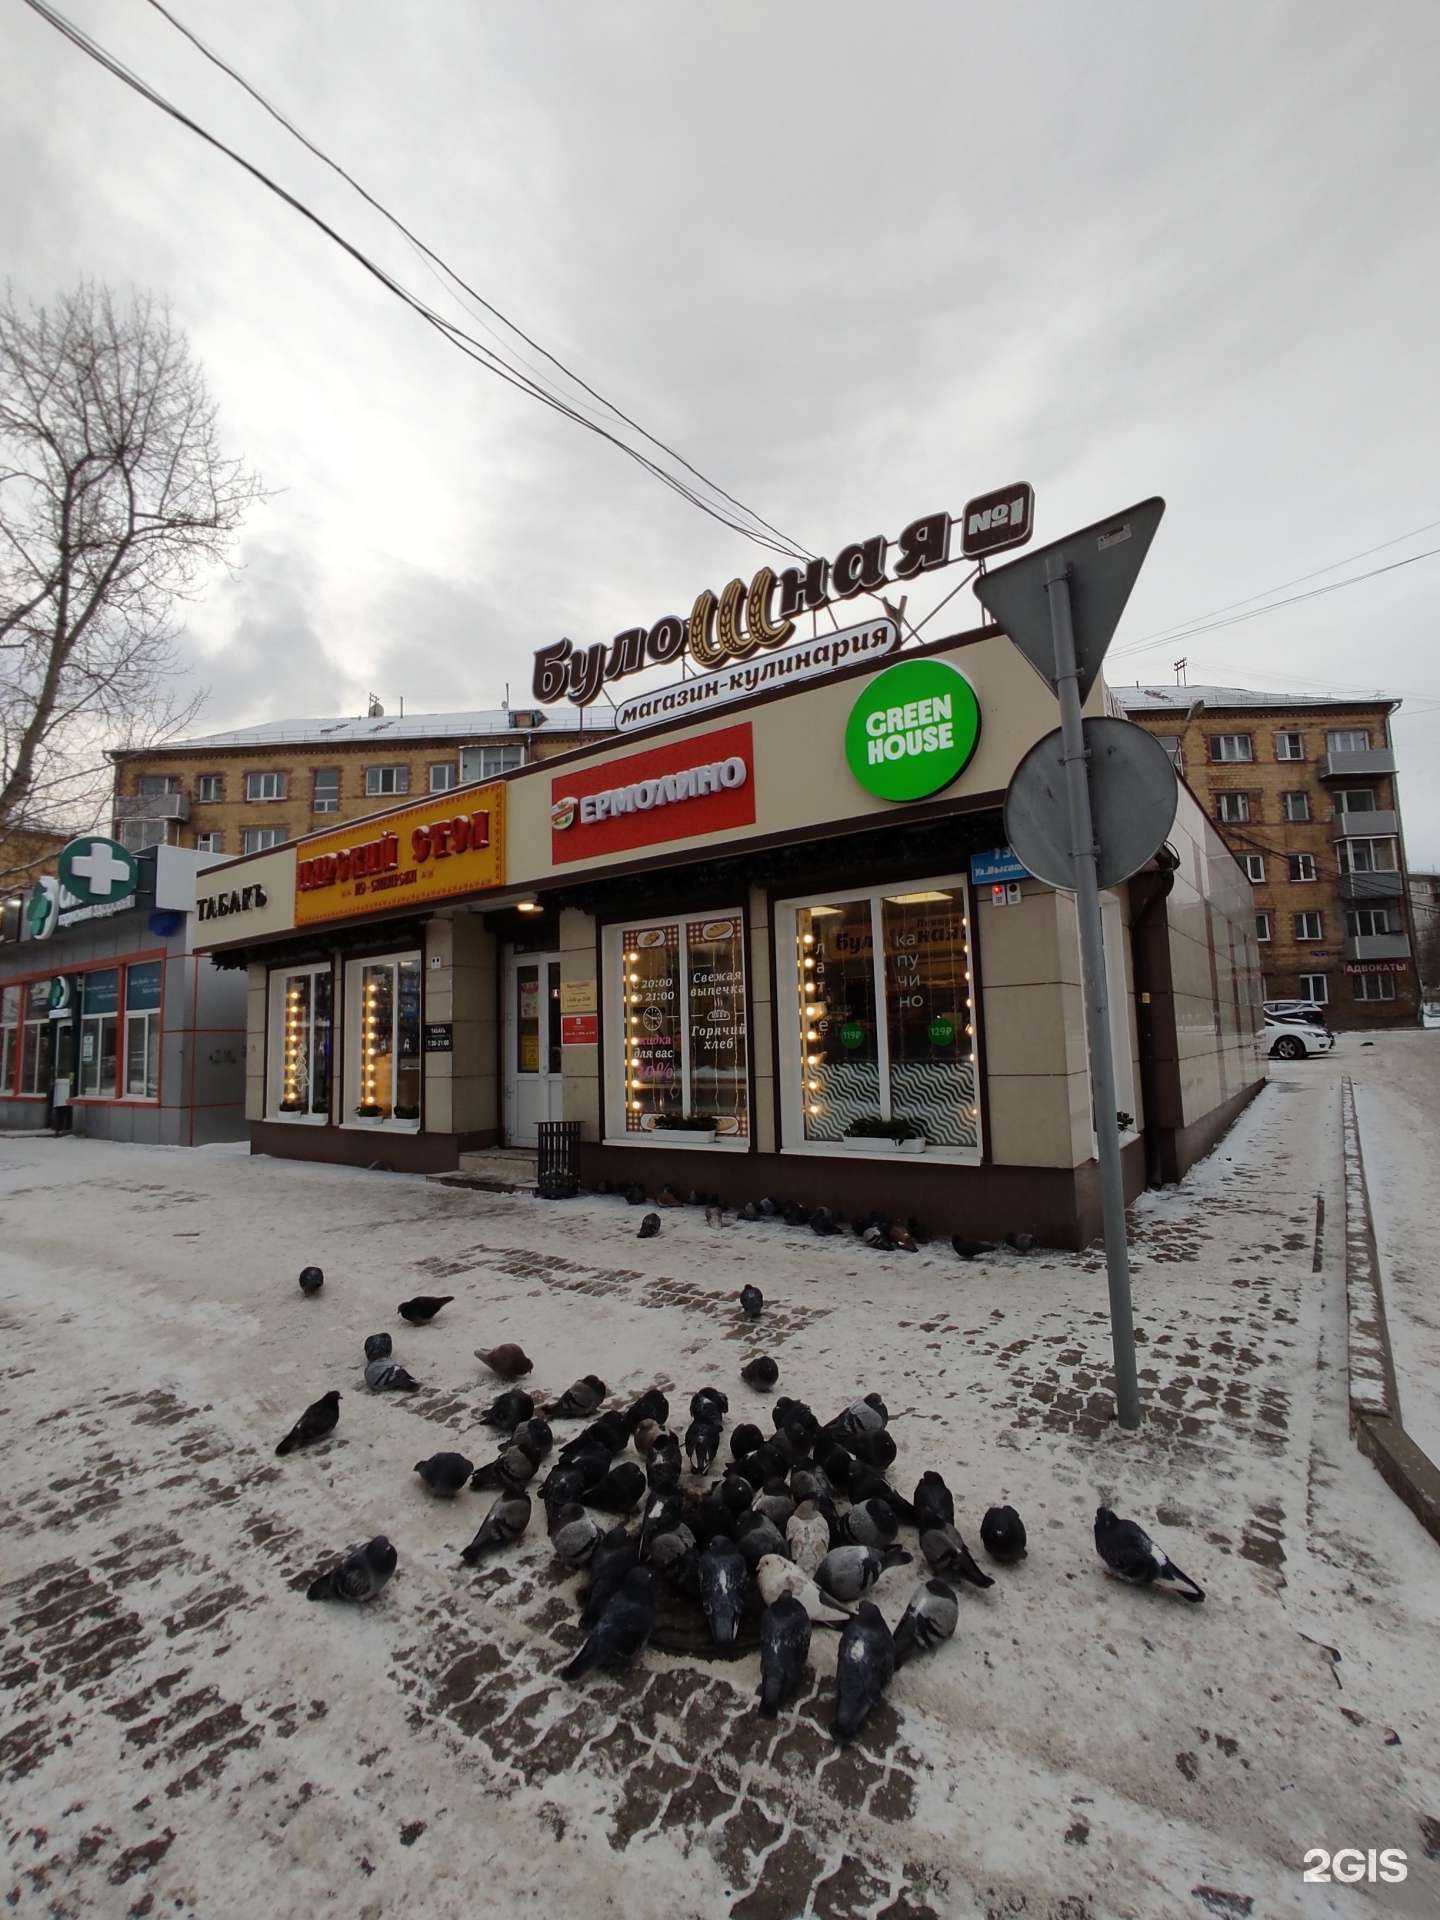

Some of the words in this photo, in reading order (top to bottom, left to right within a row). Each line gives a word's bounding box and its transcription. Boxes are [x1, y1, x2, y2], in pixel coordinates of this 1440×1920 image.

[968, 497, 1024, 535] №1
[620, 625, 889, 725] магазин-кулинария
[866, 693, 952, 737] GREEN
[868, 722, 954, 765] HOUSE
[580, 756, 747, 824] ЕРМОЛИНО
[196, 884, 267, 922] ТАБАКЪ
[1346, 963, 1407, 974] АДВОКАТЫ
[641, 978, 673, 989] 20:00
[693, 970, 742, 984] Свежая
[645, 991, 675, 1002] 21:00
[691, 1023, 747, 1039] Горячий
[704, 1038, 734, 1050] хлеб
[656, 1049, 674, 1058] вас
